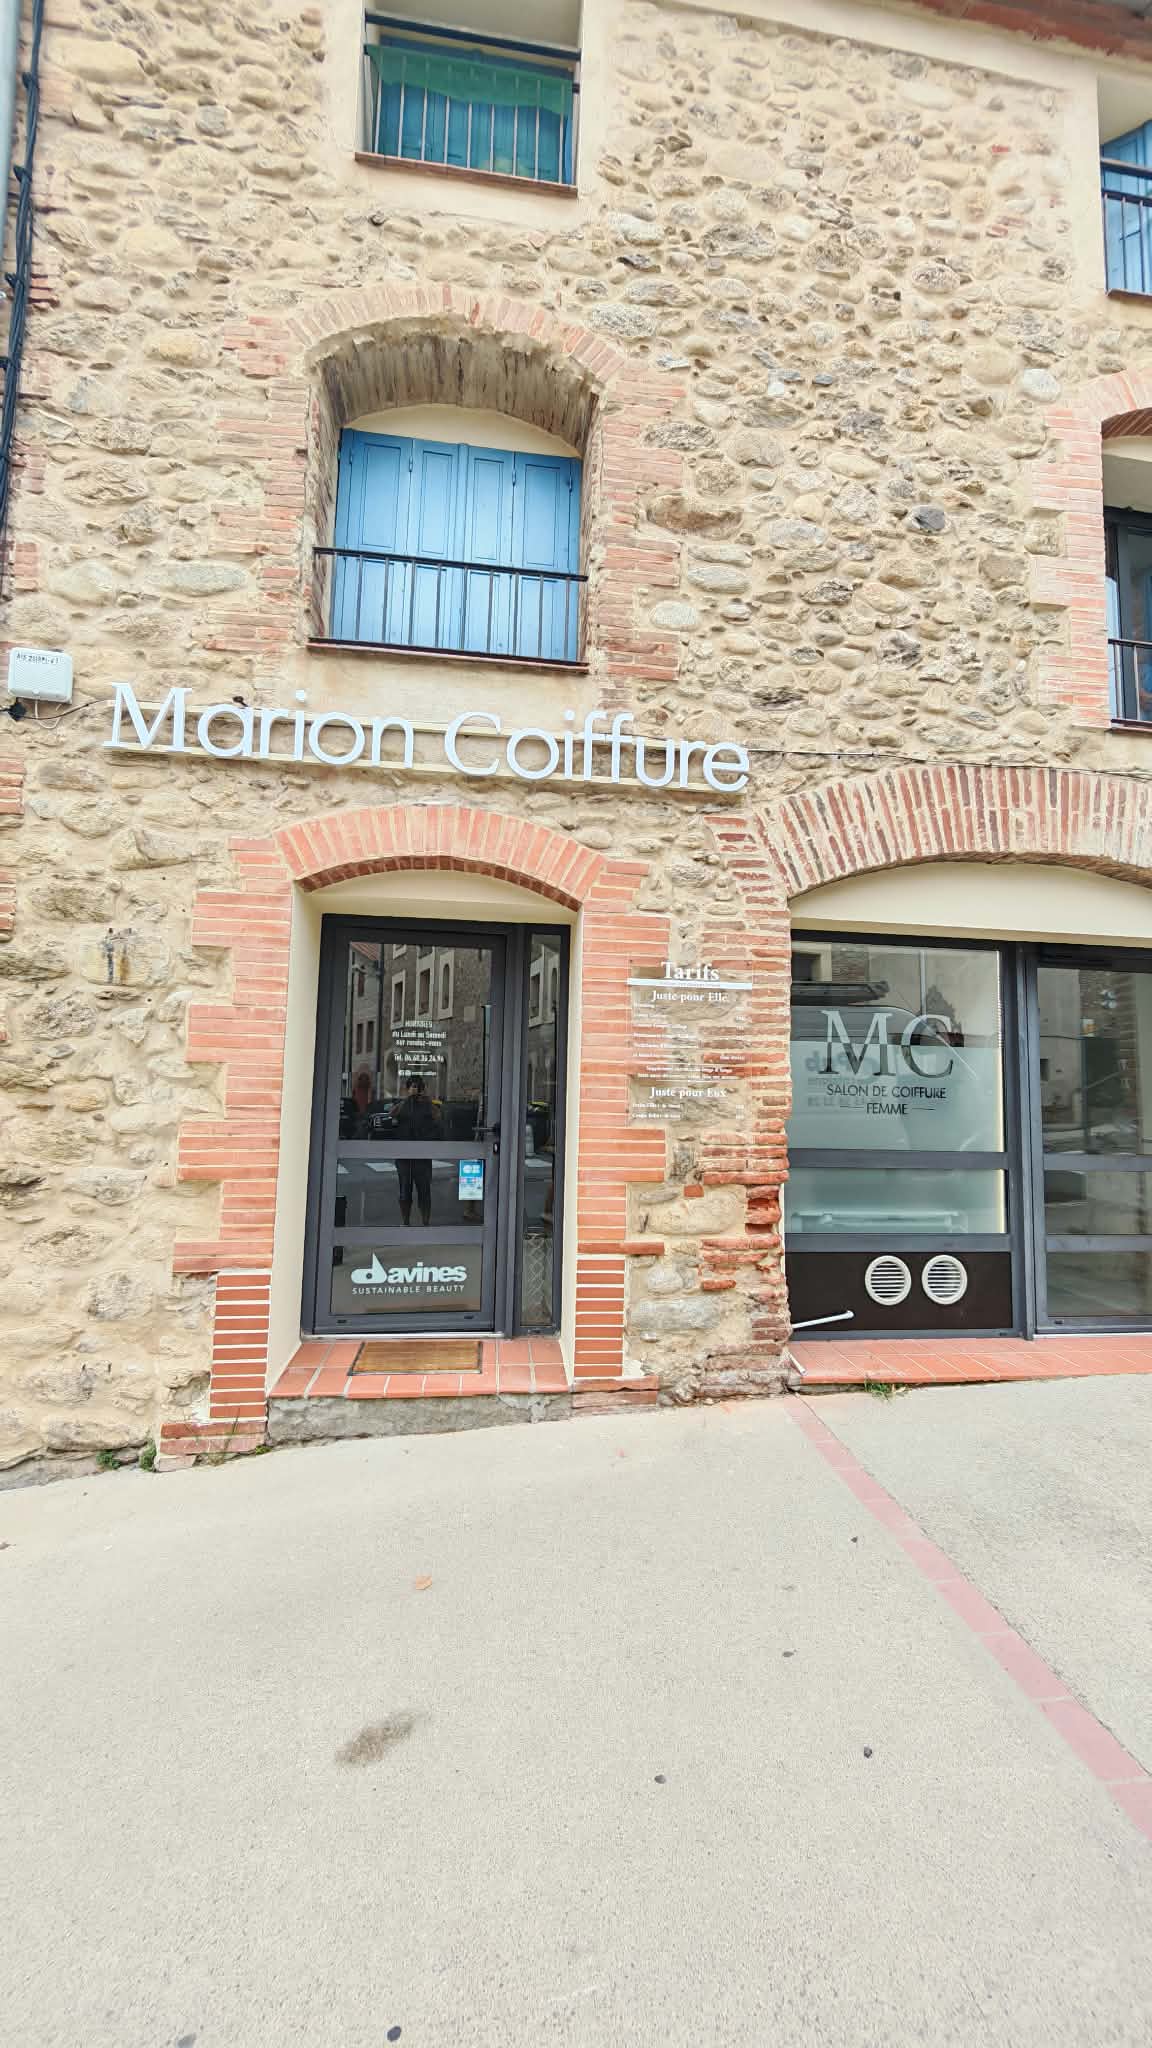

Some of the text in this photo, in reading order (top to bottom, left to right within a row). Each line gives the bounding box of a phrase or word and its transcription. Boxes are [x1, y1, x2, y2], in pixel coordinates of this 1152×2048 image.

[103, 681, 750, 793] Marion Coiffure
[661, 961, 720, 980] Tarifs
[818, 1010, 955, 1079] MC
[649, 1087, 677, 1098] Juste
[680, 1089, 704, 1098] pour
[826, 1083, 947, 1098] SALON DE COIFFURE
[866, 1102, 908, 1115] FEMME
[350, 1252, 468, 1284] davines
[351, 1285, 465, 1295] SUSTAINABLE BEAUTY
